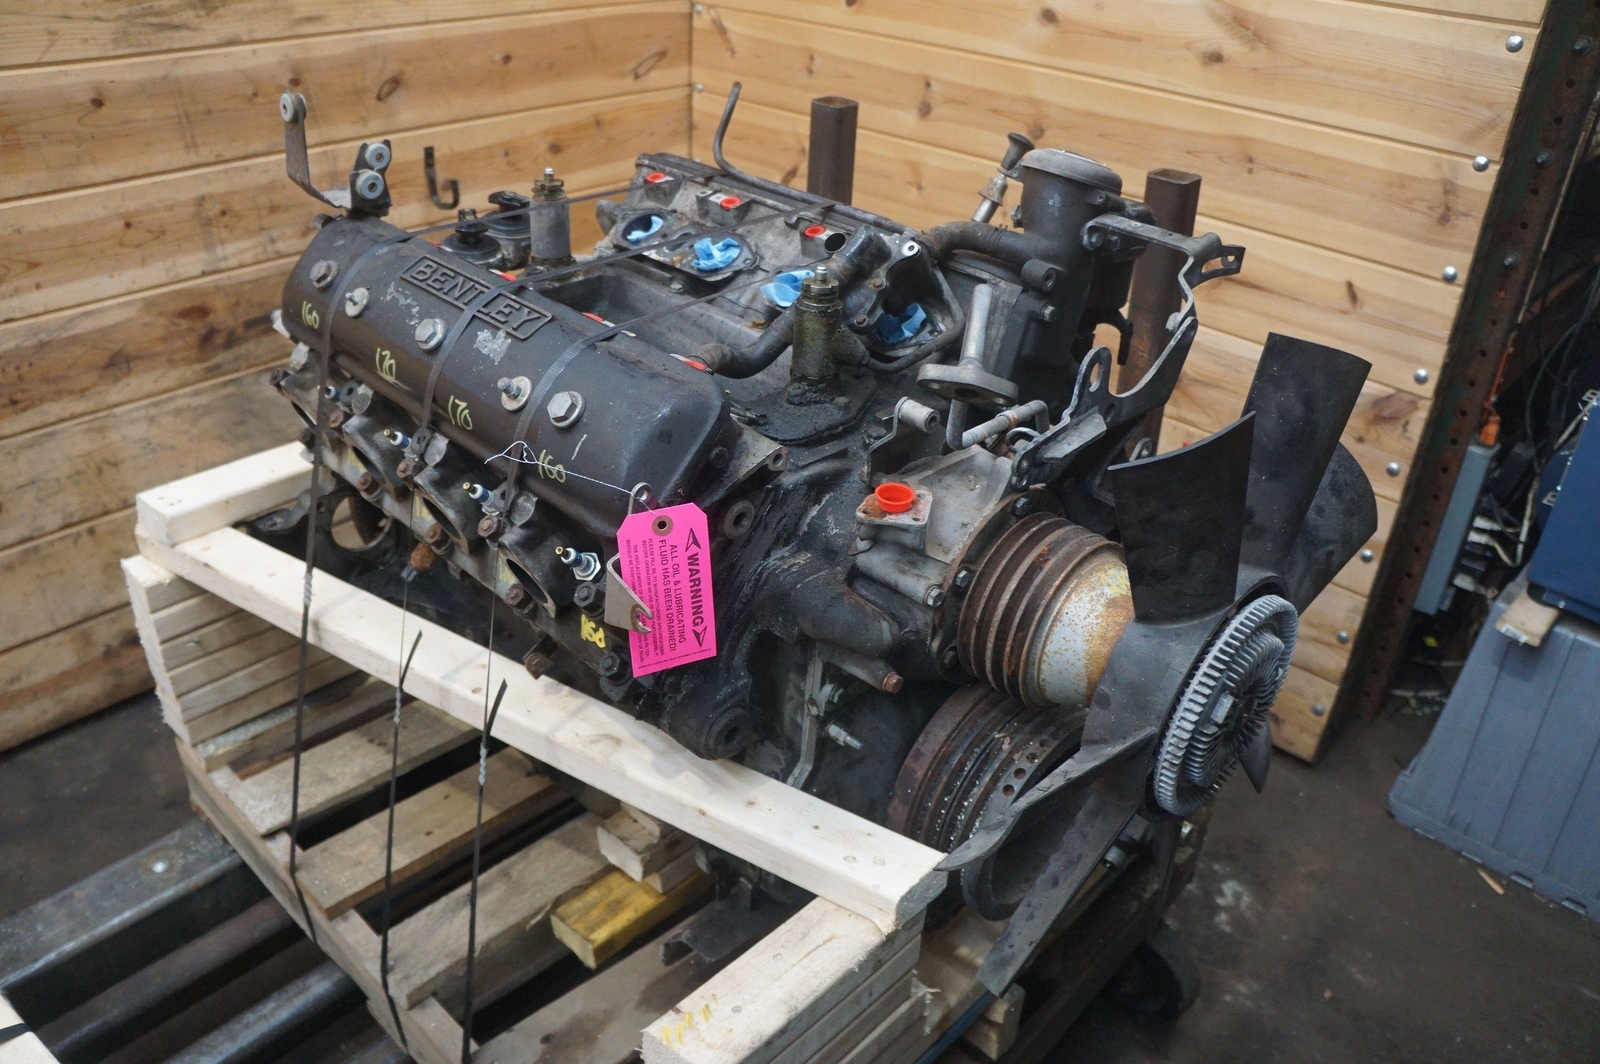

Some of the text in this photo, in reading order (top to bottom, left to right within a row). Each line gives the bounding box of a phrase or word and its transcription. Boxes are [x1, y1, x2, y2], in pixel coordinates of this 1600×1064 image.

[302, 301, 319, 329] 160
[538, 449, 567, 484] 160
[669, 544, 678, 561] ALL
[634, 554, 642, 587] REPLACEMENT
[671, 563, 680, 578] OIL
[658, 539, 676, 651] FLUID HAS BEEN DRAINED!
[688, 552, 705, 627] WARNING
[674, 587, 686, 643] LUBRICATING
